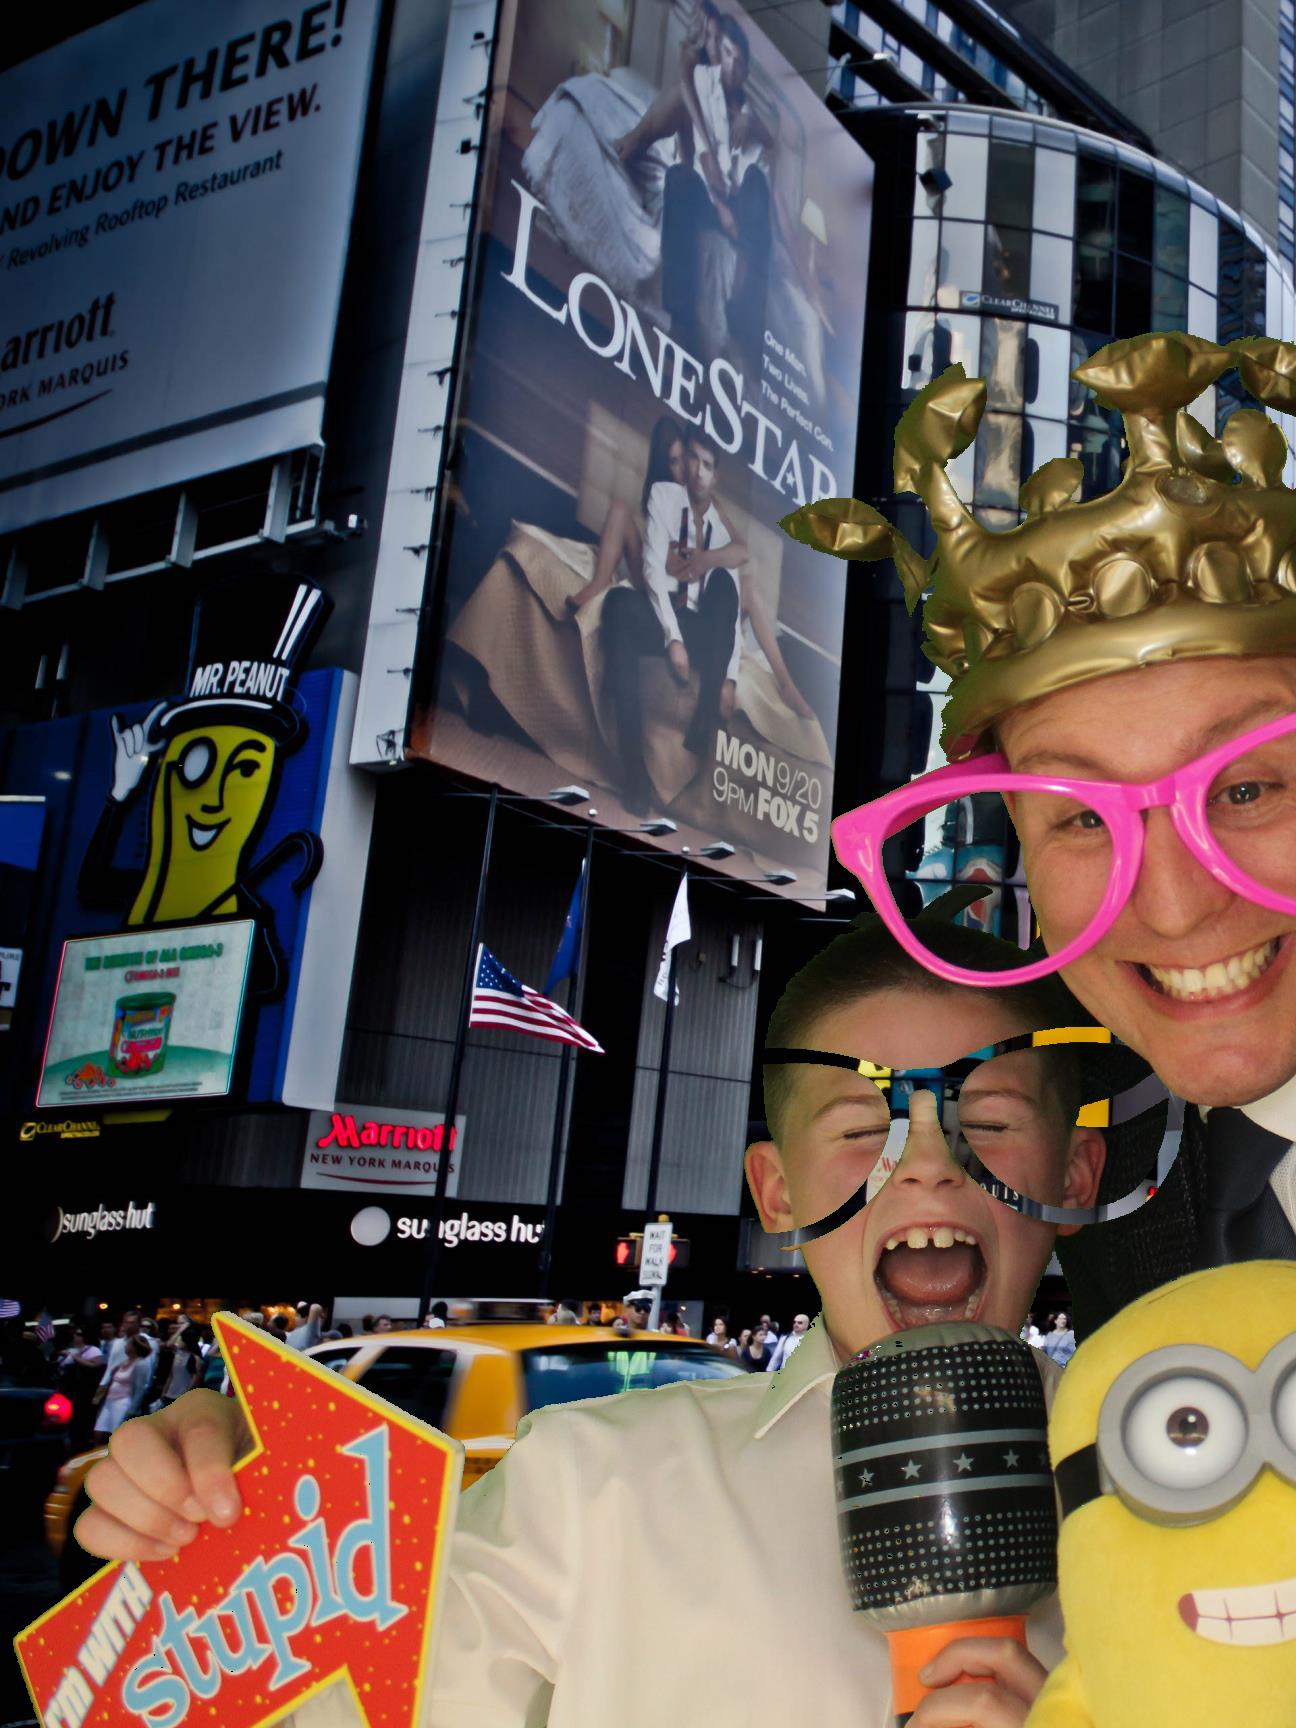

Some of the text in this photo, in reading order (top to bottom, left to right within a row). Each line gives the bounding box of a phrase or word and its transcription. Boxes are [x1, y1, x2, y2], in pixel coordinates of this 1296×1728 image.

[143, 0, 348, 122] THERE!
[0, 83, 321, 236] ND ENJOY THE VIEW.
[7, 150, 282, 270] Revolving Rooftop Restaurant
[0, 292, 116, 373] arriott
[762, 354, 782, 381] Two
[764, 330, 783, 356] One
[37, 349, 129, 396] MARQUIS
[761, 379, 779, 405] The
[781, 397, 813, 434] Perfect
[225, 660, 290, 701] PEANUT
[713, 767, 820, 843] 9PM FOX 5
[716, 729, 822, 809] MON 9/20
[310, 1153, 455, 1174] NEW YORK MARQUS
[62, 1201, 155, 1239] sunglass hut
[122, 1422, 410, 1728] stupid
[76, 1561, 154, 1688] WITH
